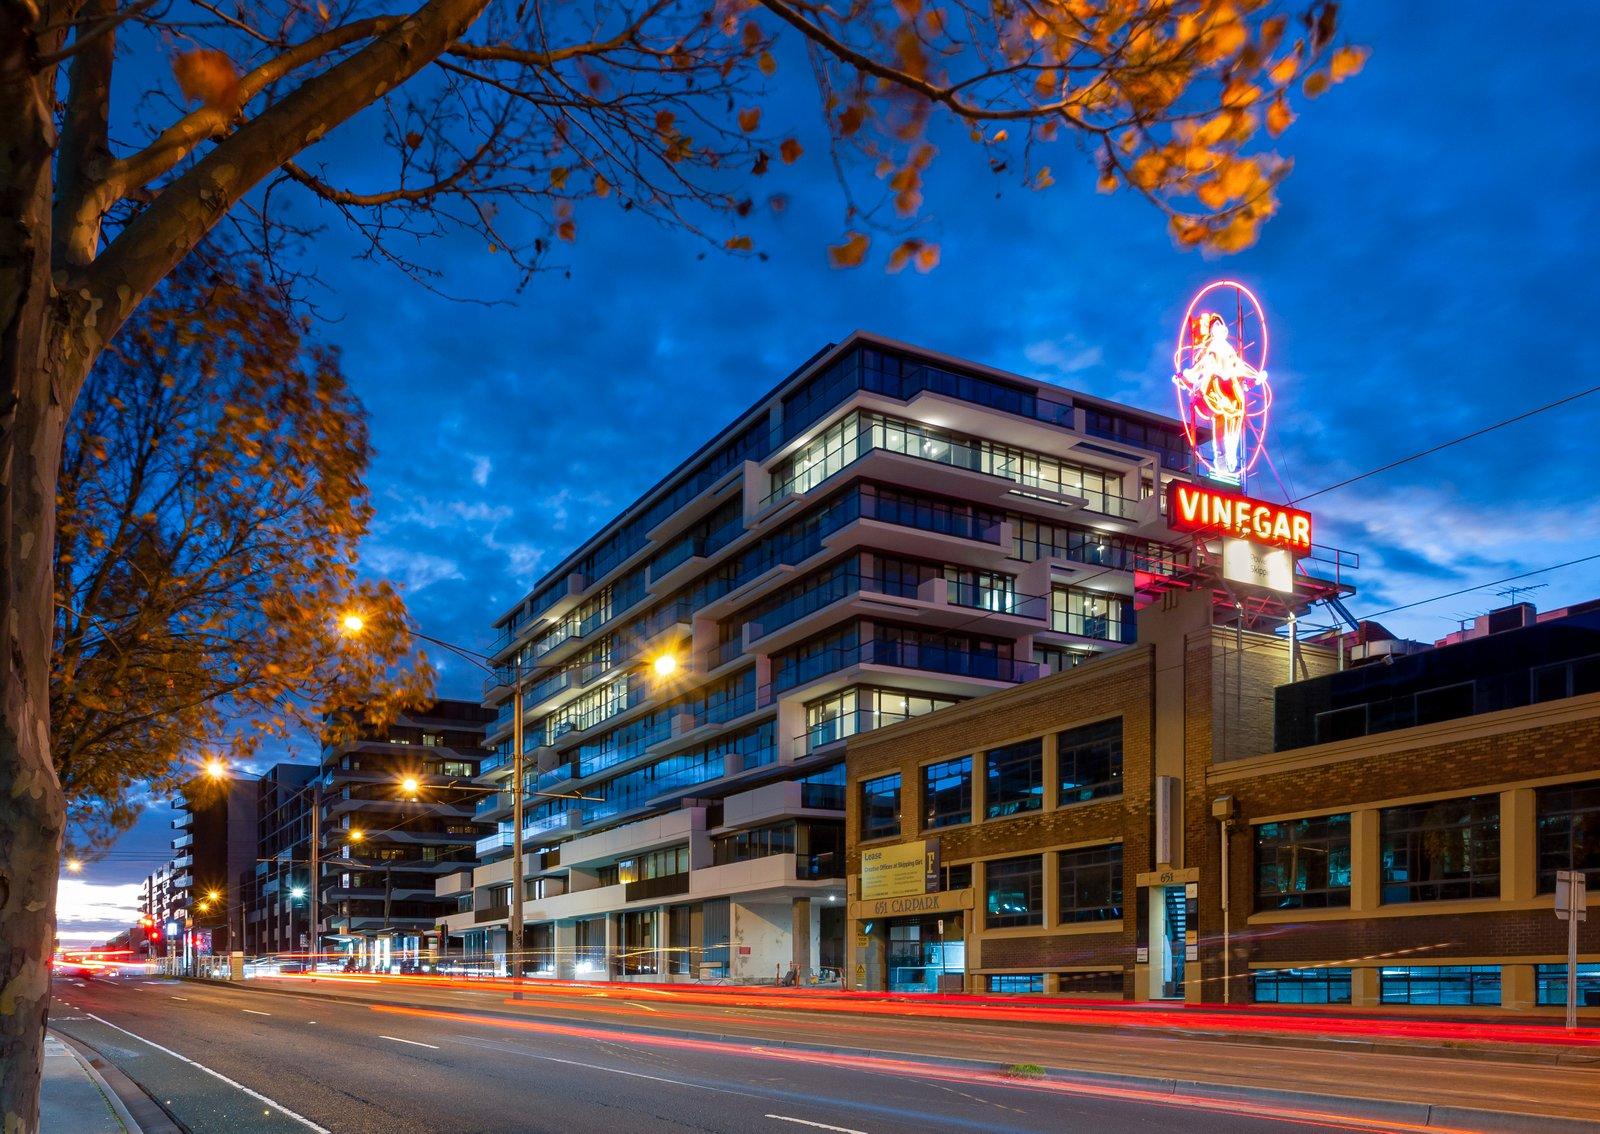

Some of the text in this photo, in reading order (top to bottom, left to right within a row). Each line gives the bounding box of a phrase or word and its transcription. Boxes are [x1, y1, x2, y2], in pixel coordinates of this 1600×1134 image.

[1178, 488, 1310, 547] VINEGAR
[864, 852, 882, 861] Lease
[897, 861, 915, 869] Skipping
[915, 858, 923, 866] Girl
[1160, 872, 1174, 883] 651
[875, 896, 940, 915] 651 CARPARK
